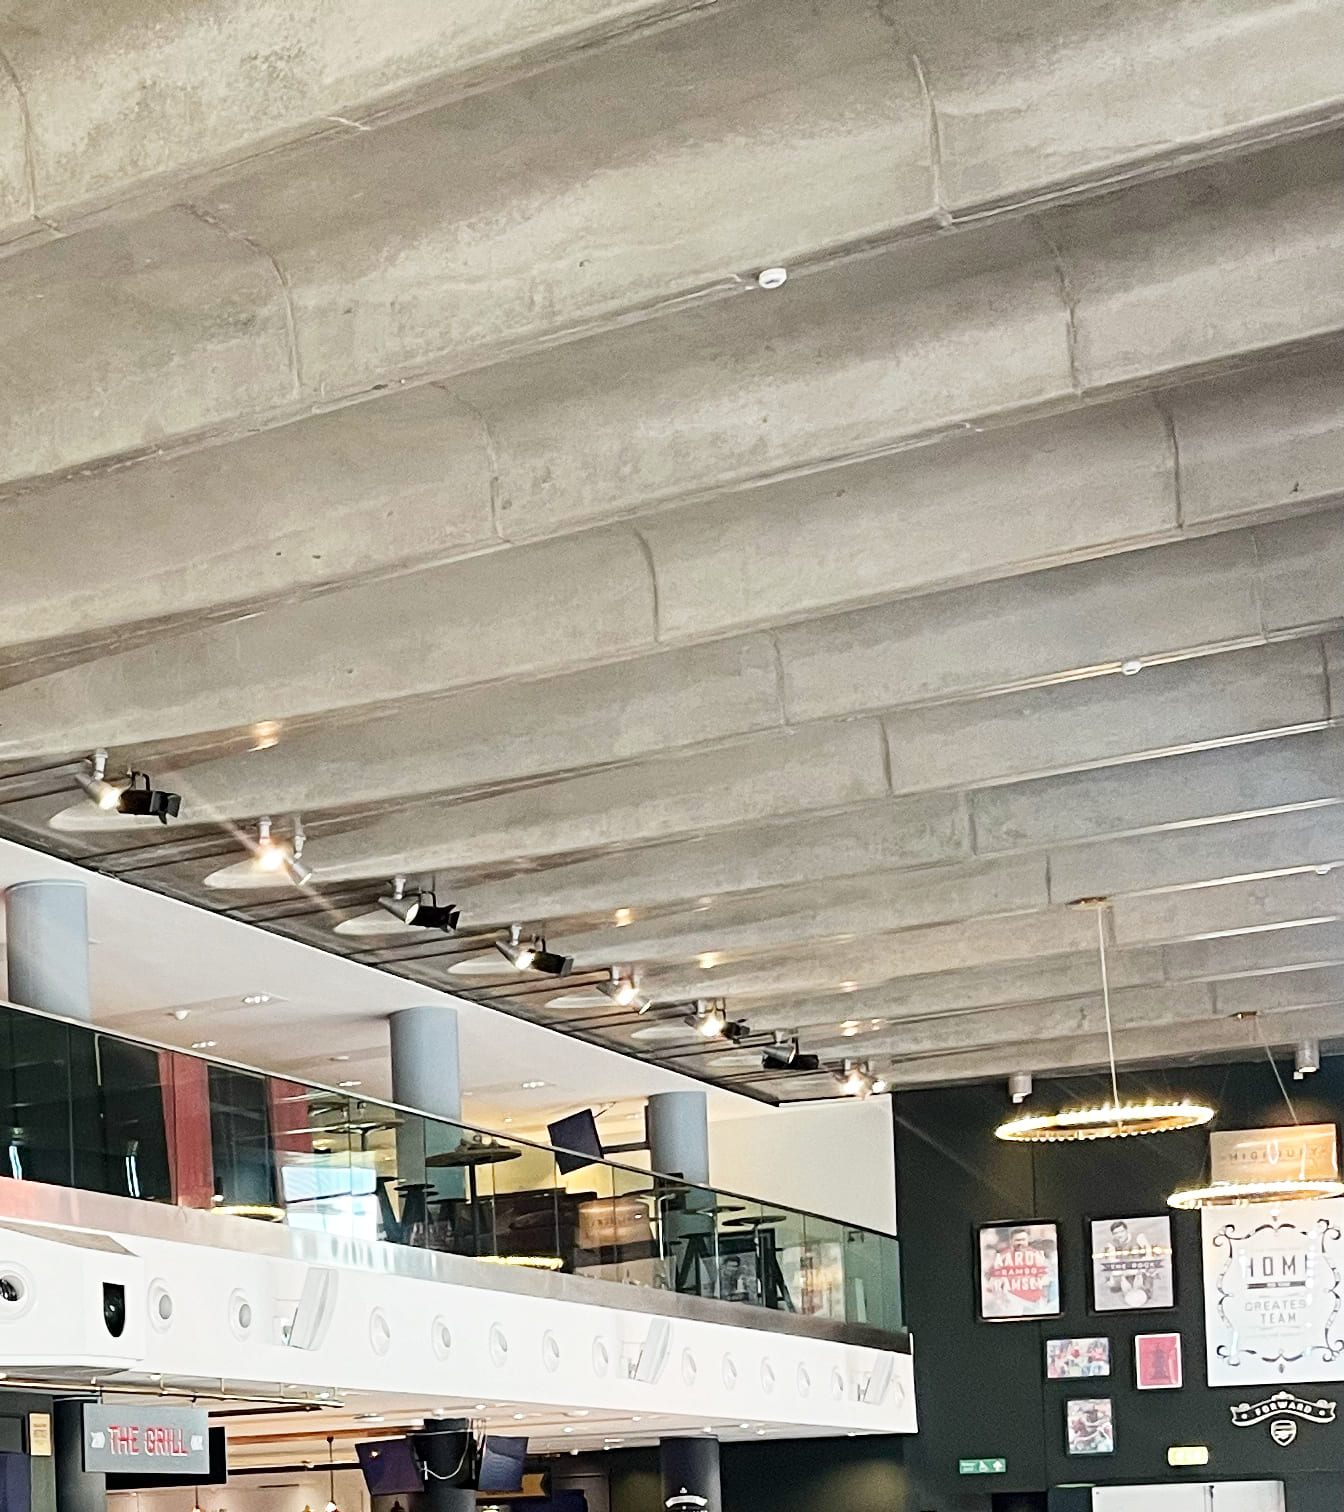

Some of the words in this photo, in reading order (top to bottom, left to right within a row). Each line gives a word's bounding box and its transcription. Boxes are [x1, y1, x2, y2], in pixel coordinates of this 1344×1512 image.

[1260, 1313, 1296, 1324] TEAM
[1255, 1401, 1312, 1416] FORWARD
[107, 1424, 139, 1456] THE
[144, 1427, 189, 1457] GRILL
